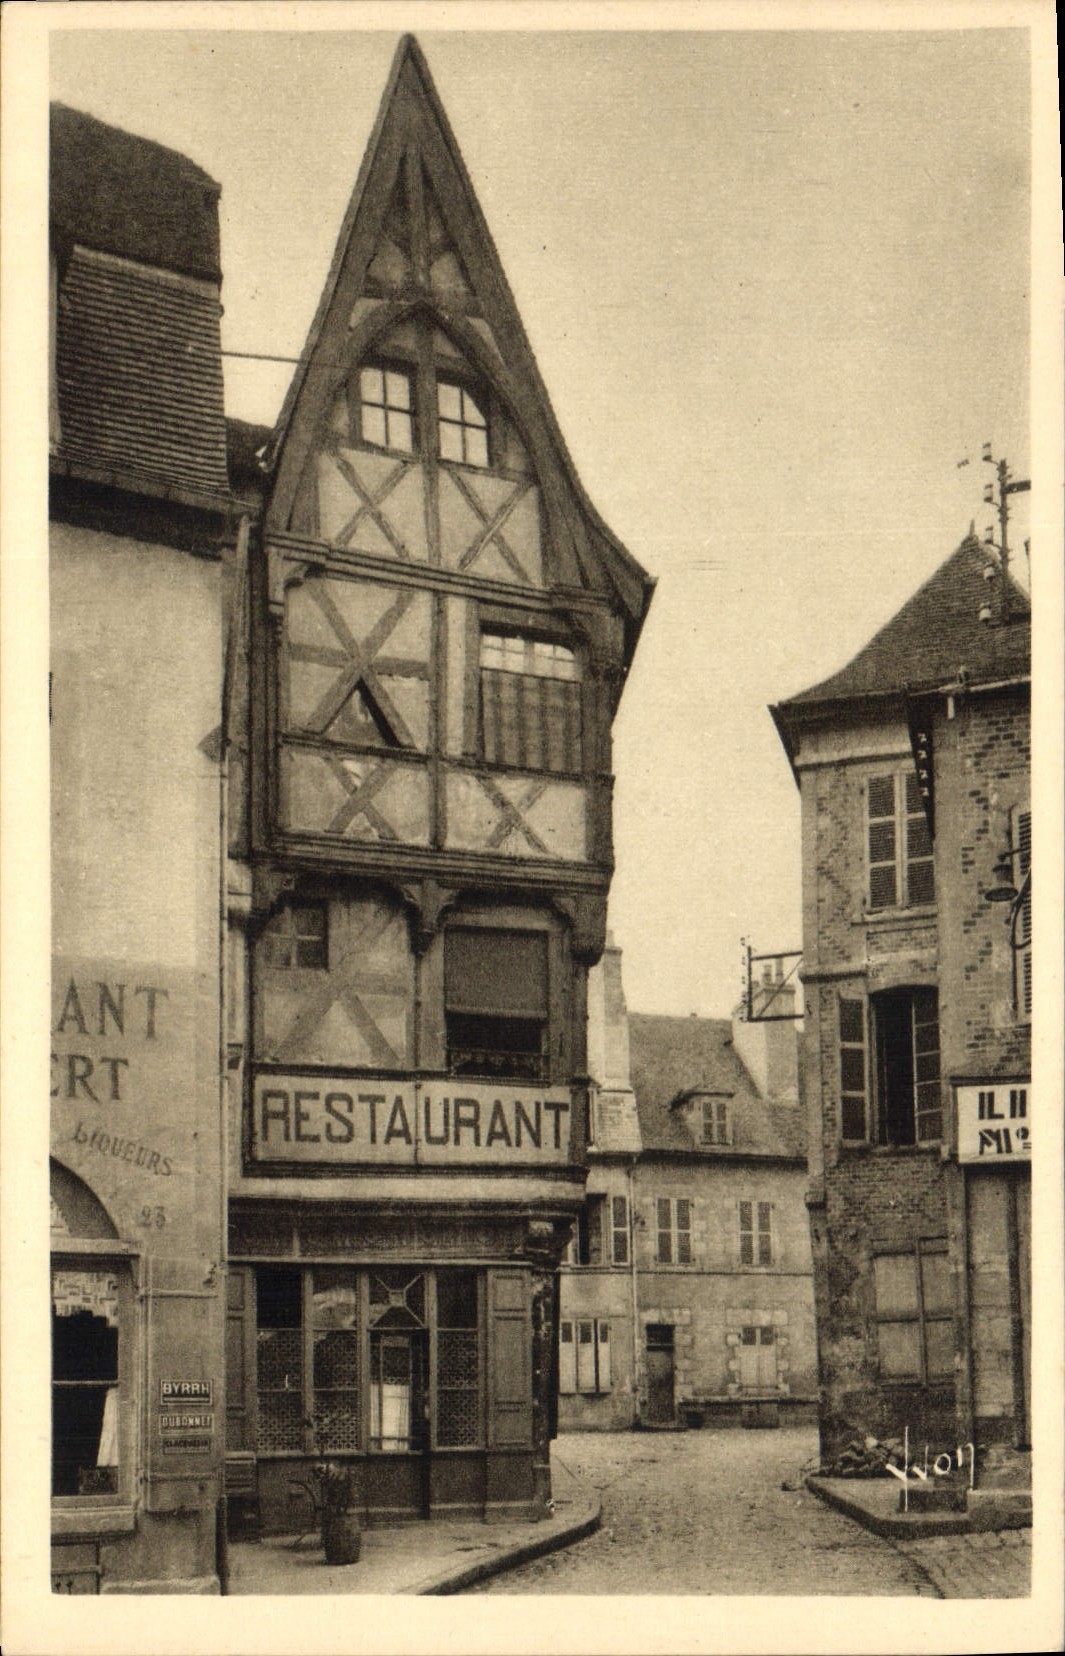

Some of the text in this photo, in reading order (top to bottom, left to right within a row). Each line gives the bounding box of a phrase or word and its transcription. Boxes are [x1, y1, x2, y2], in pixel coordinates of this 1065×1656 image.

[261, 1089, 570, 1150] RESTAURANT
[73, 1121, 173, 1177] LIQUEURS
[163, 1382, 209, 1394] BYRRH
